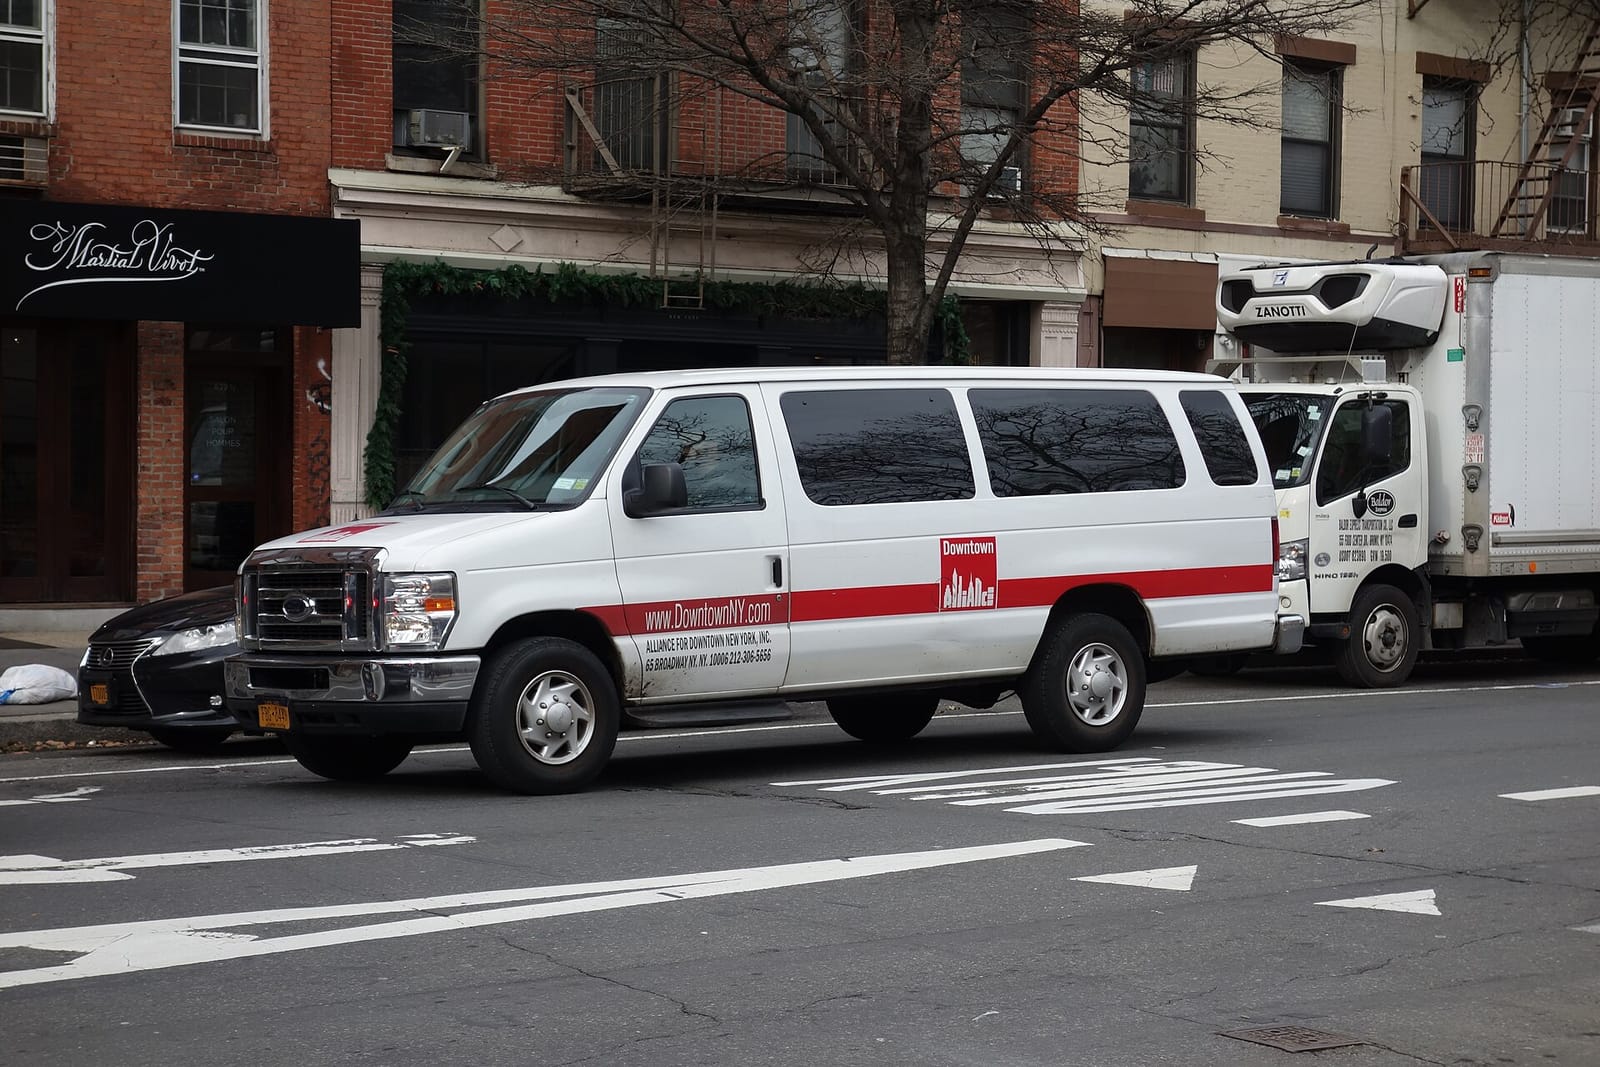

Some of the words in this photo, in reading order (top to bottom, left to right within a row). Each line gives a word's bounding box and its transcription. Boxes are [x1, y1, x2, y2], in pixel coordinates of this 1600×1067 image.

[25, 220, 144, 271] Martial
[131, 219, 215, 272] Vivot
[1255, 305, 1306, 318] ZANOTTI
[943, 539, 994, 556] Downtown
[645, 598, 772, 631] www.DowntownNY.com
[646, 638, 675, 654] ALLIANCE
[676, 637, 689, 651] FOR
[689, 634, 725, 650] DOWNTOWN
[725, 633, 740, 646] NEW
[740, 631, 758, 645] YORK,
[758, 630, 772, 645] INC.
[645, 658, 654, 672] 65
[654, 655, 689, 671] BROADWAY
[709, 652, 729, 667] 10006
[729, 648, 772, 665] 212-306-5656
